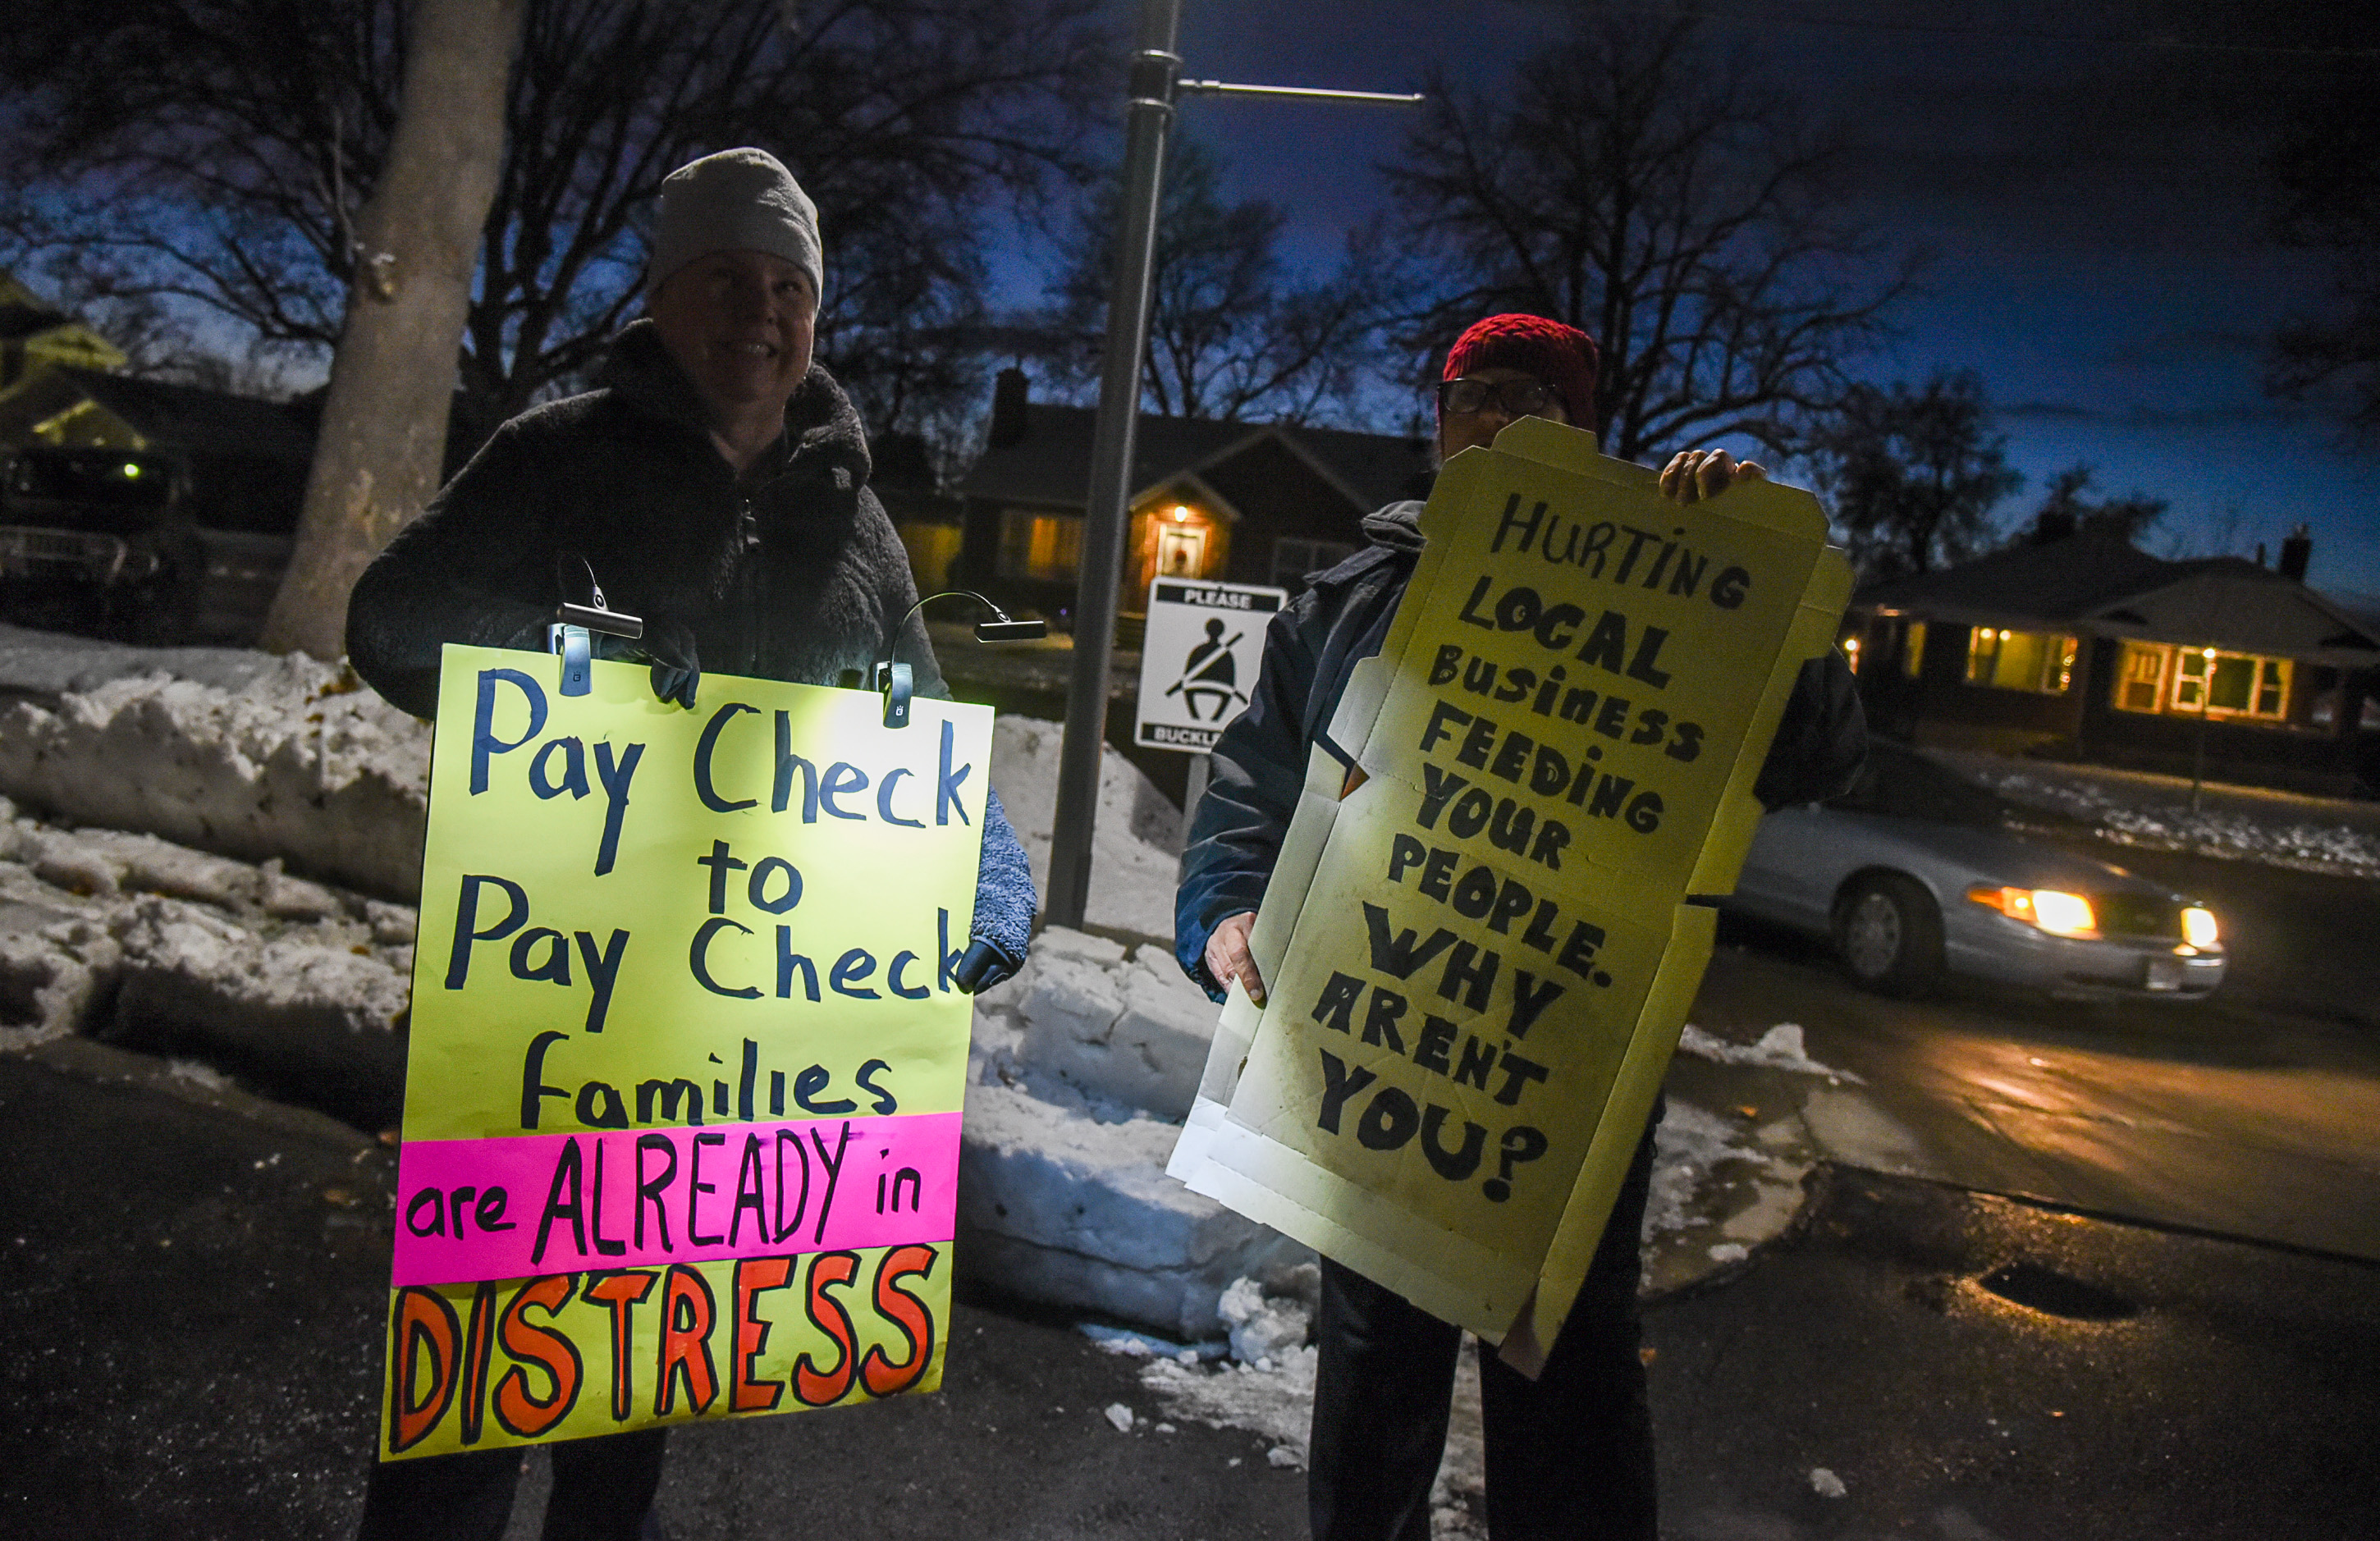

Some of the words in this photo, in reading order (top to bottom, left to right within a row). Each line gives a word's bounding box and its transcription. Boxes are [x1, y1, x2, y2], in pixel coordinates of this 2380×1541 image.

[1184, 588, 1252, 609] PLEASE
[1458, 576, 1670, 688] LOCAL
[469, 668, 646, 876] Pay
[693, 703, 971, 827] Check
[1416, 762, 1572, 870] YOUR
[697, 839, 803, 914] to
[1388, 833, 1613, 987] PEOPLE.
[445, 874, 630, 1032] Pay
[689, 908, 963, 1001] Check
[1362, 900, 1567, 1040] WHY
[520, 1031, 897, 1129] families
[1311, 970, 1549, 1106] AREN'T
[405, 1186, 516, 1239] are
[530, 1121, 850, 1266] ALREADY
[875, 1149, 922, 1214] in
[1317, 1047, 1549, 1203] YOU?
[388, 1243, 938, 1453] DISTRESS
